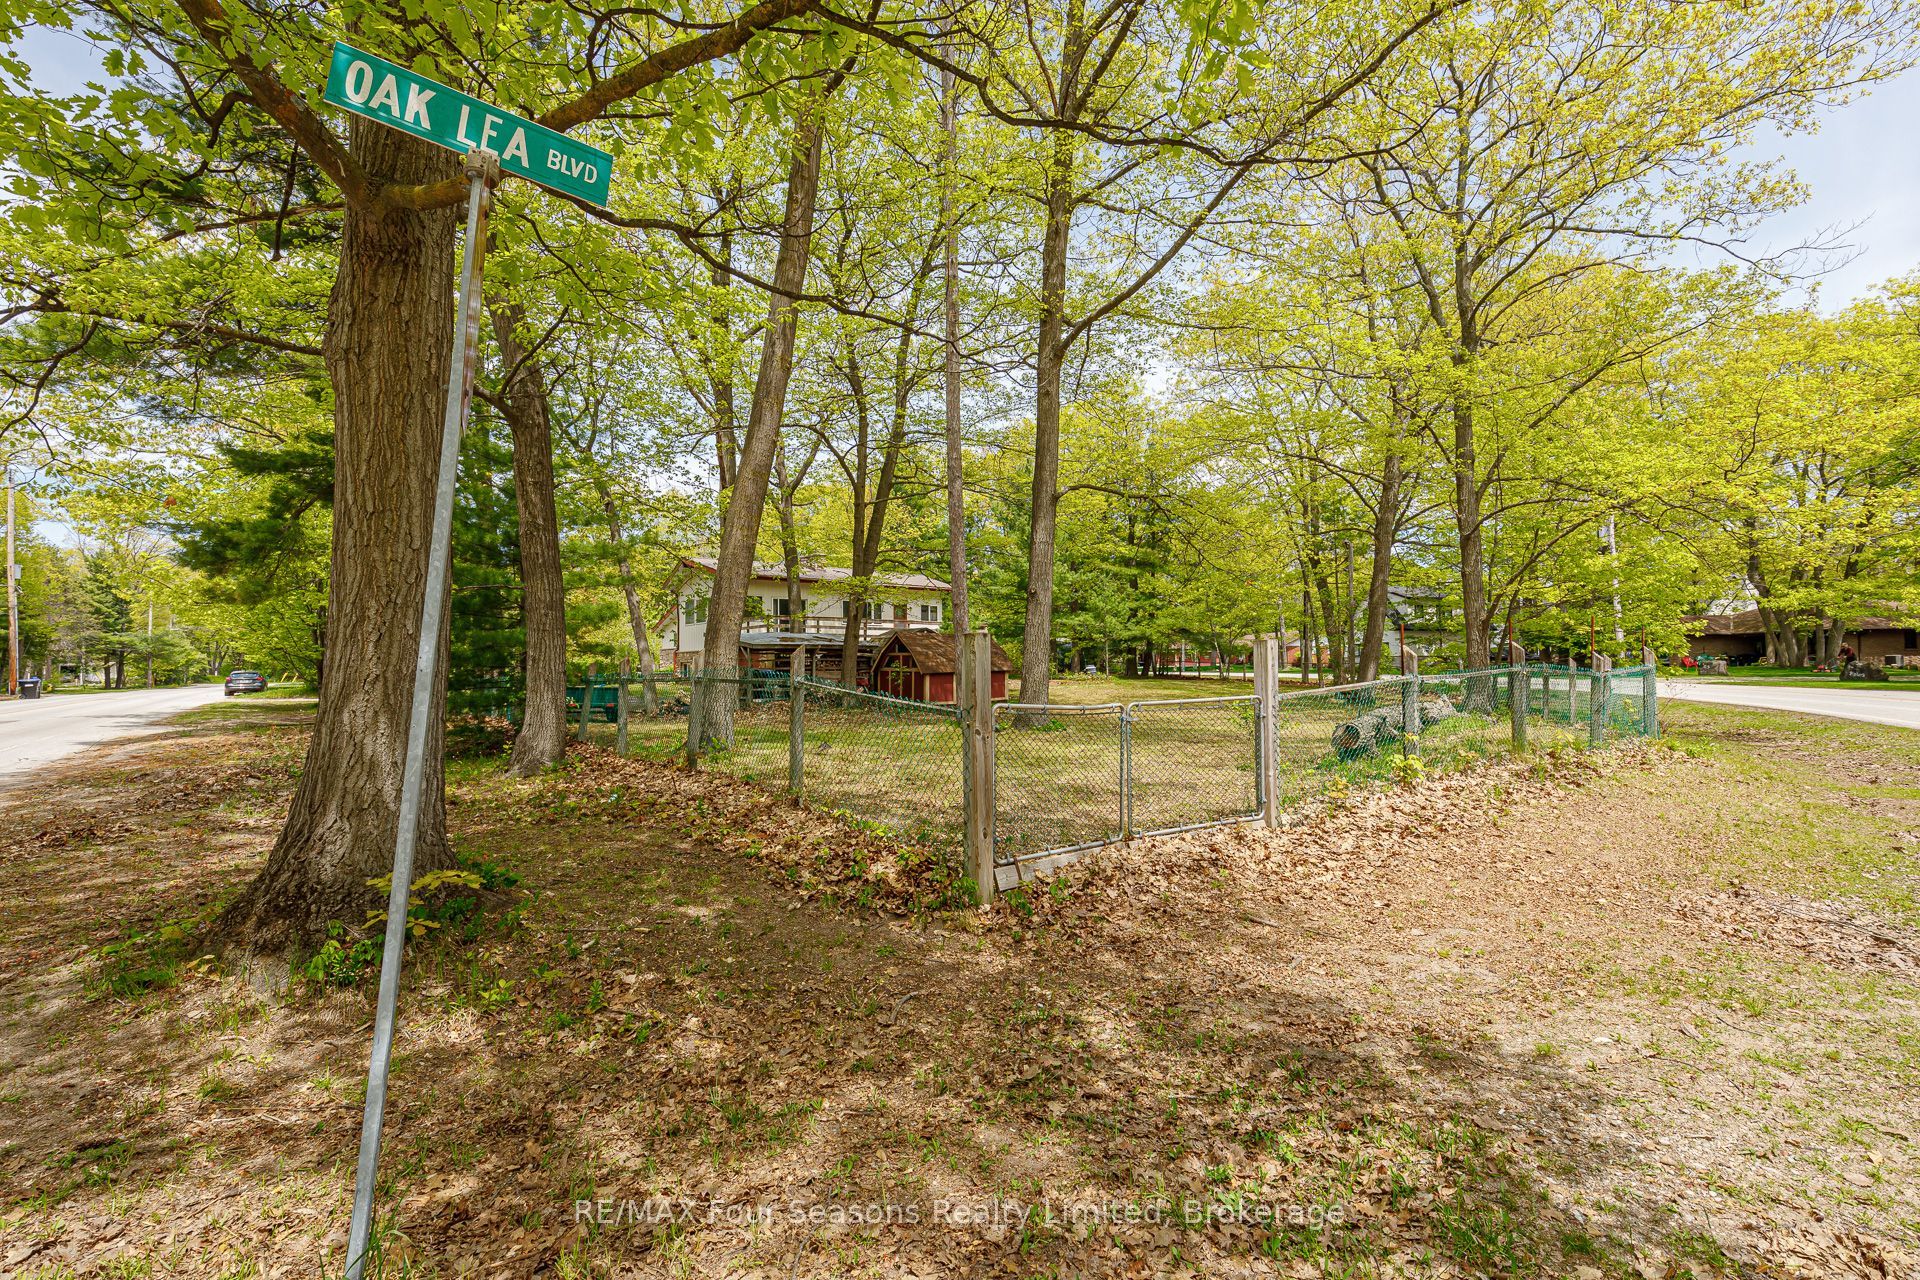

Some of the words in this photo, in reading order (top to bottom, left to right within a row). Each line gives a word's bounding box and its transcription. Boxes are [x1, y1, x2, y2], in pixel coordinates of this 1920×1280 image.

[345, 60, 436, 130] OAK
[456, 104, 530, 169] LEA
[546, 148, 598, 184] BLVD
